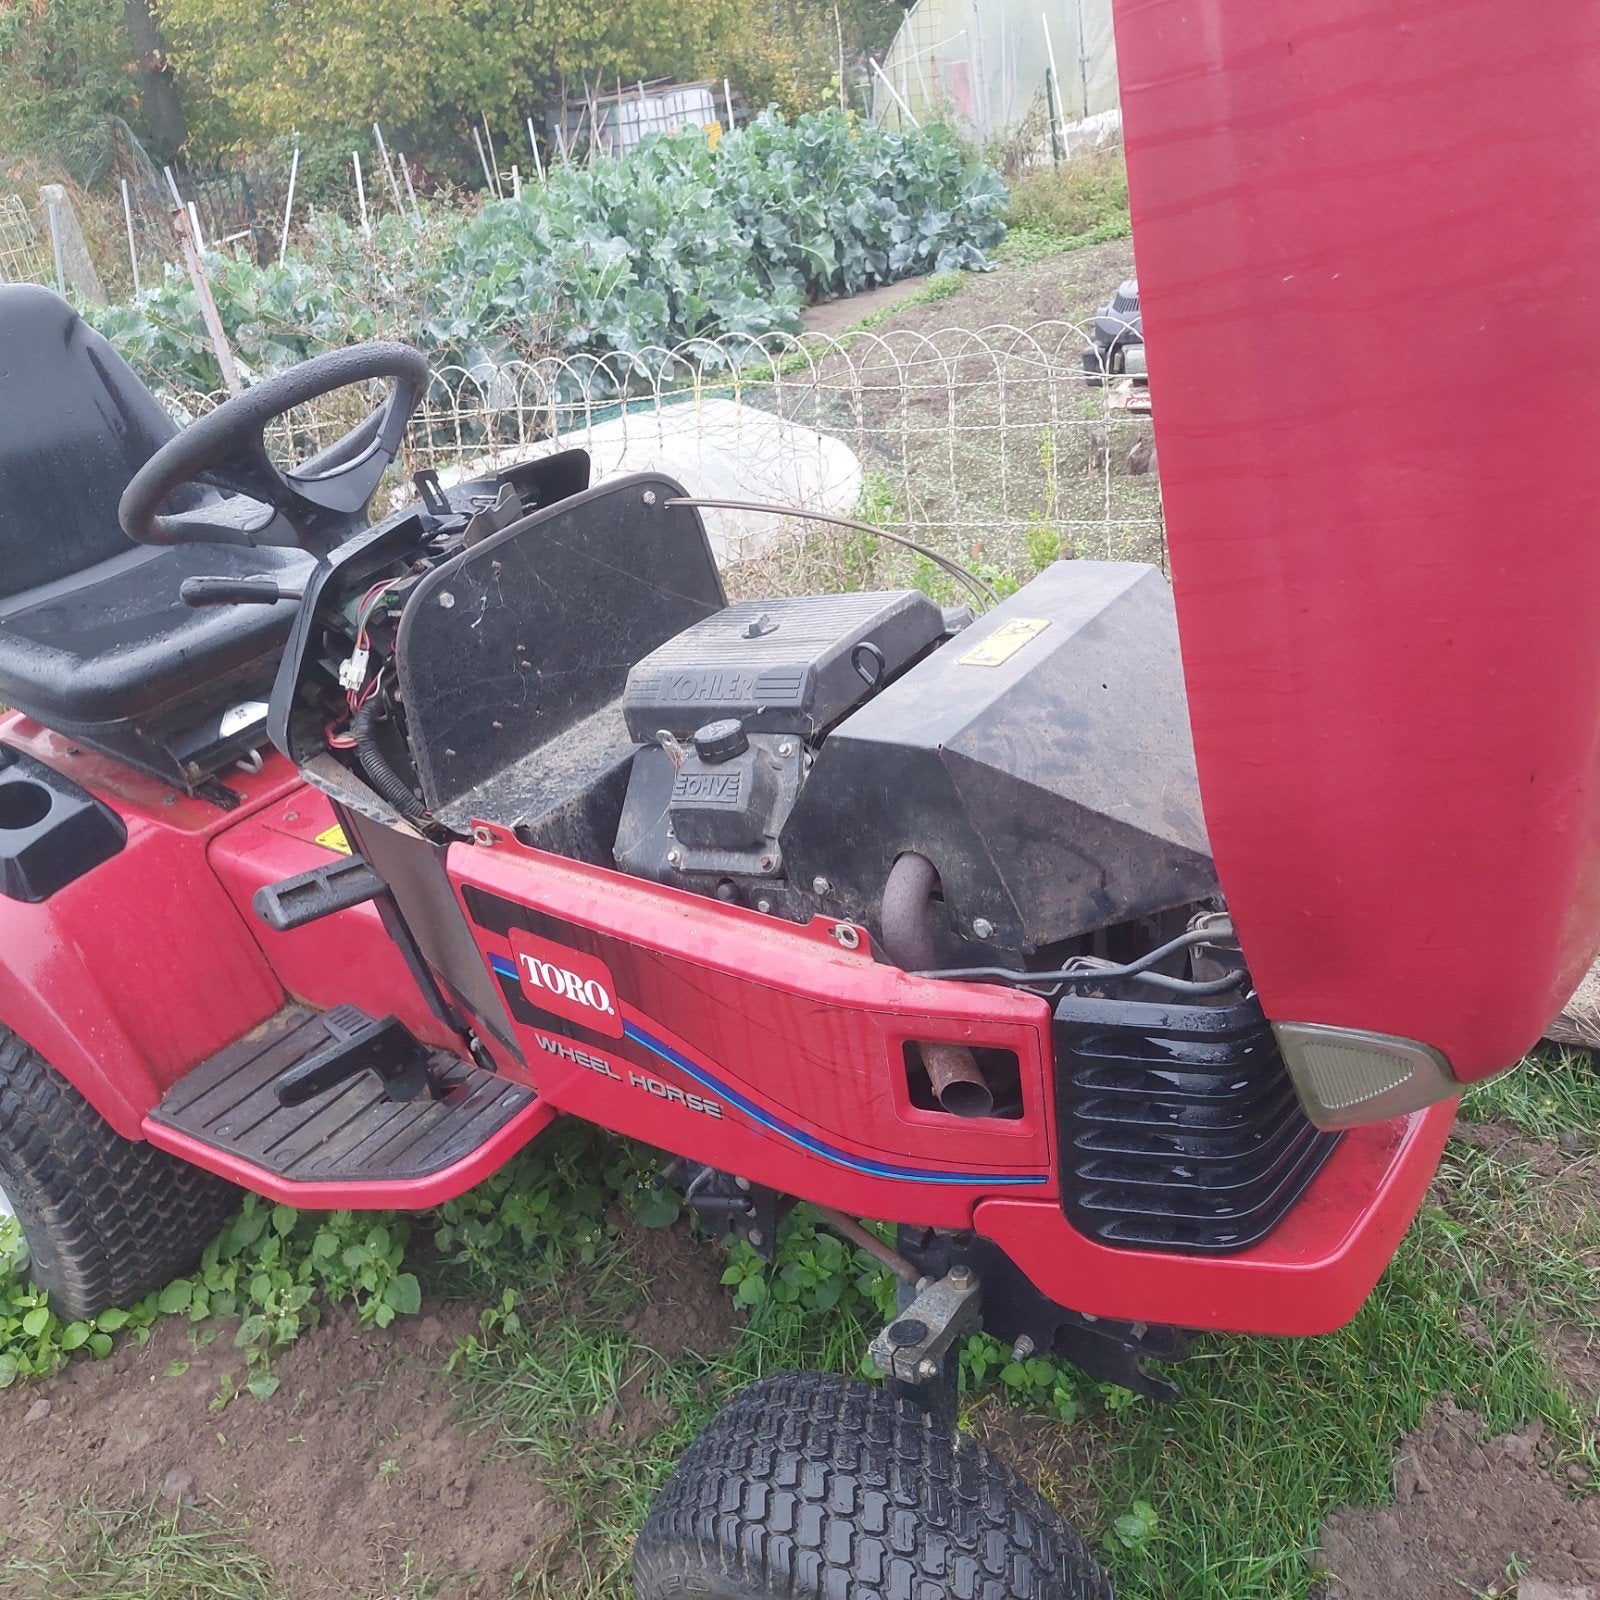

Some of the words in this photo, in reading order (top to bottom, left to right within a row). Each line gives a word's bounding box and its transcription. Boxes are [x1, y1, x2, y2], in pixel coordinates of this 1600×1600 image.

[661, 675, 753, 700] KOHLER
[534, 1033, 623, 1081] WHEEL
[628, 1070, 723, 1119] HORSE
